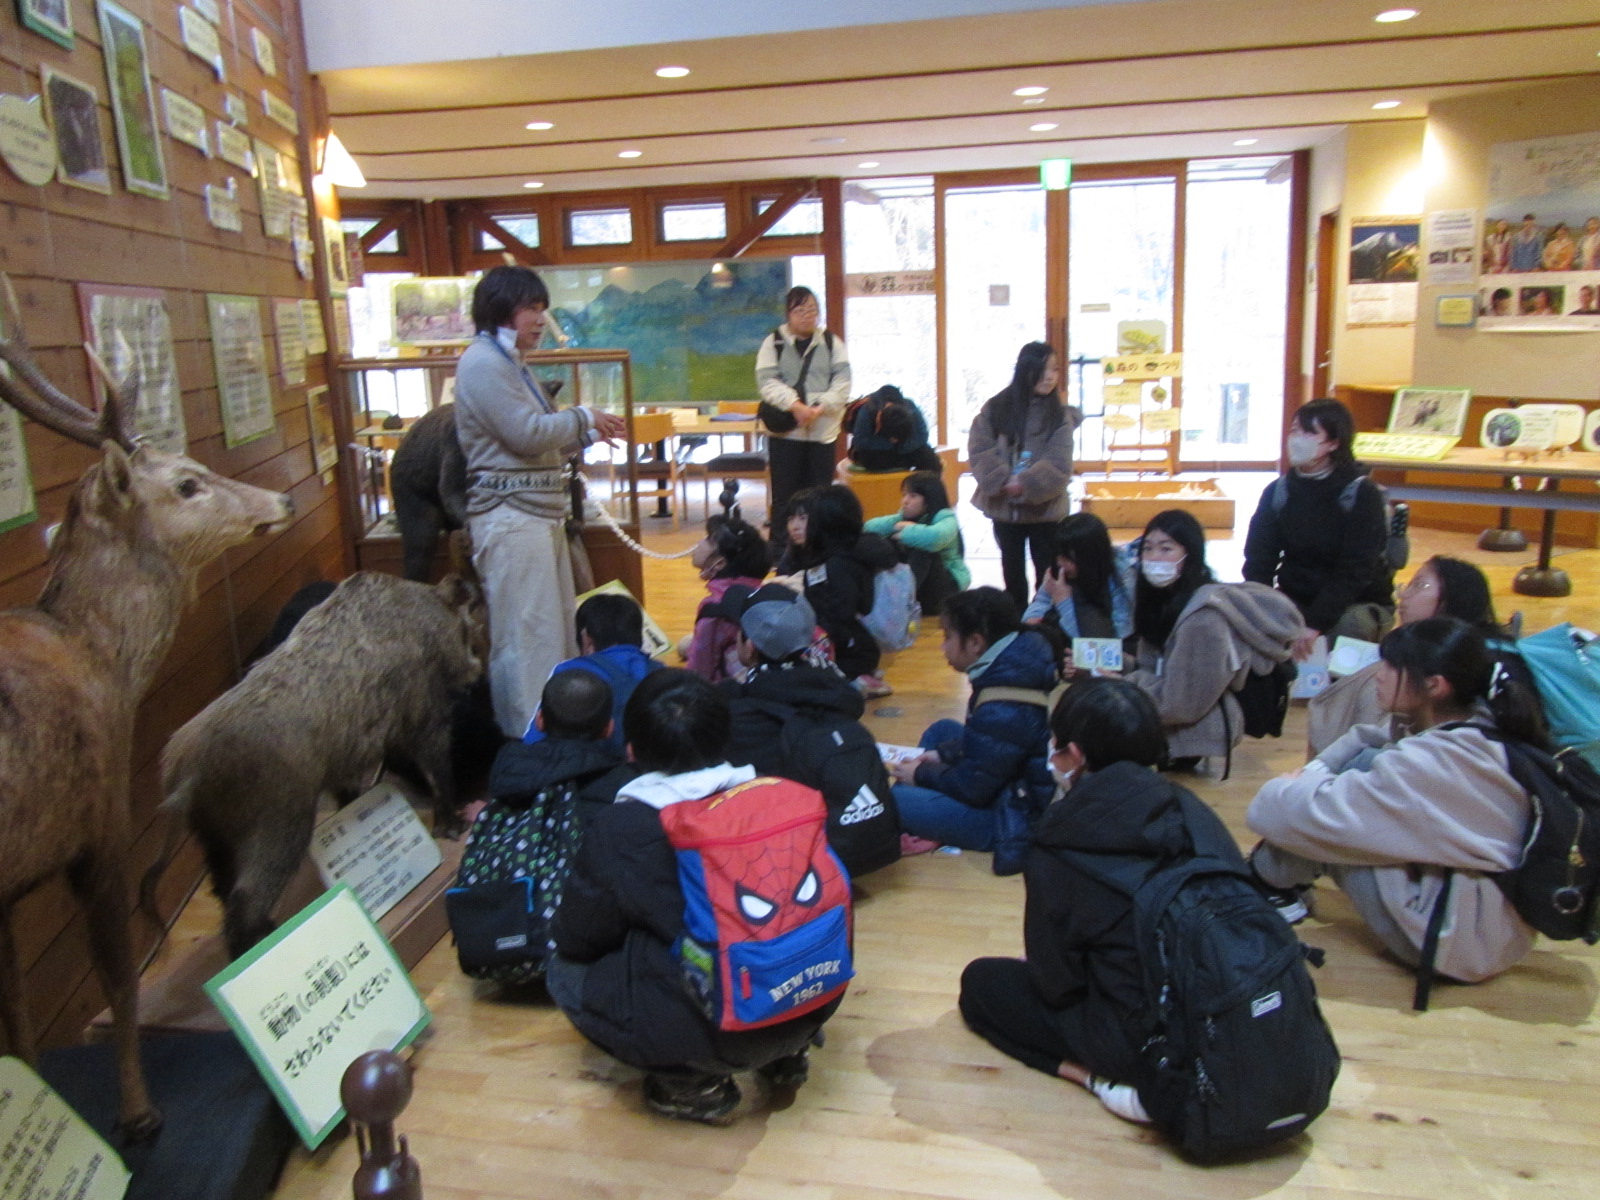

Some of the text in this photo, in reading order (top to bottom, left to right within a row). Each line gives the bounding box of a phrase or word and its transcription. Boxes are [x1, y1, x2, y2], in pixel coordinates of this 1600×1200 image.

[839, 802, 885, 826] adidas
[768, 959, 842, 1003] NEW YORK
[792, 980, 824, 1006] 1962
[283, 966, 393, 1079] さわらないでください
